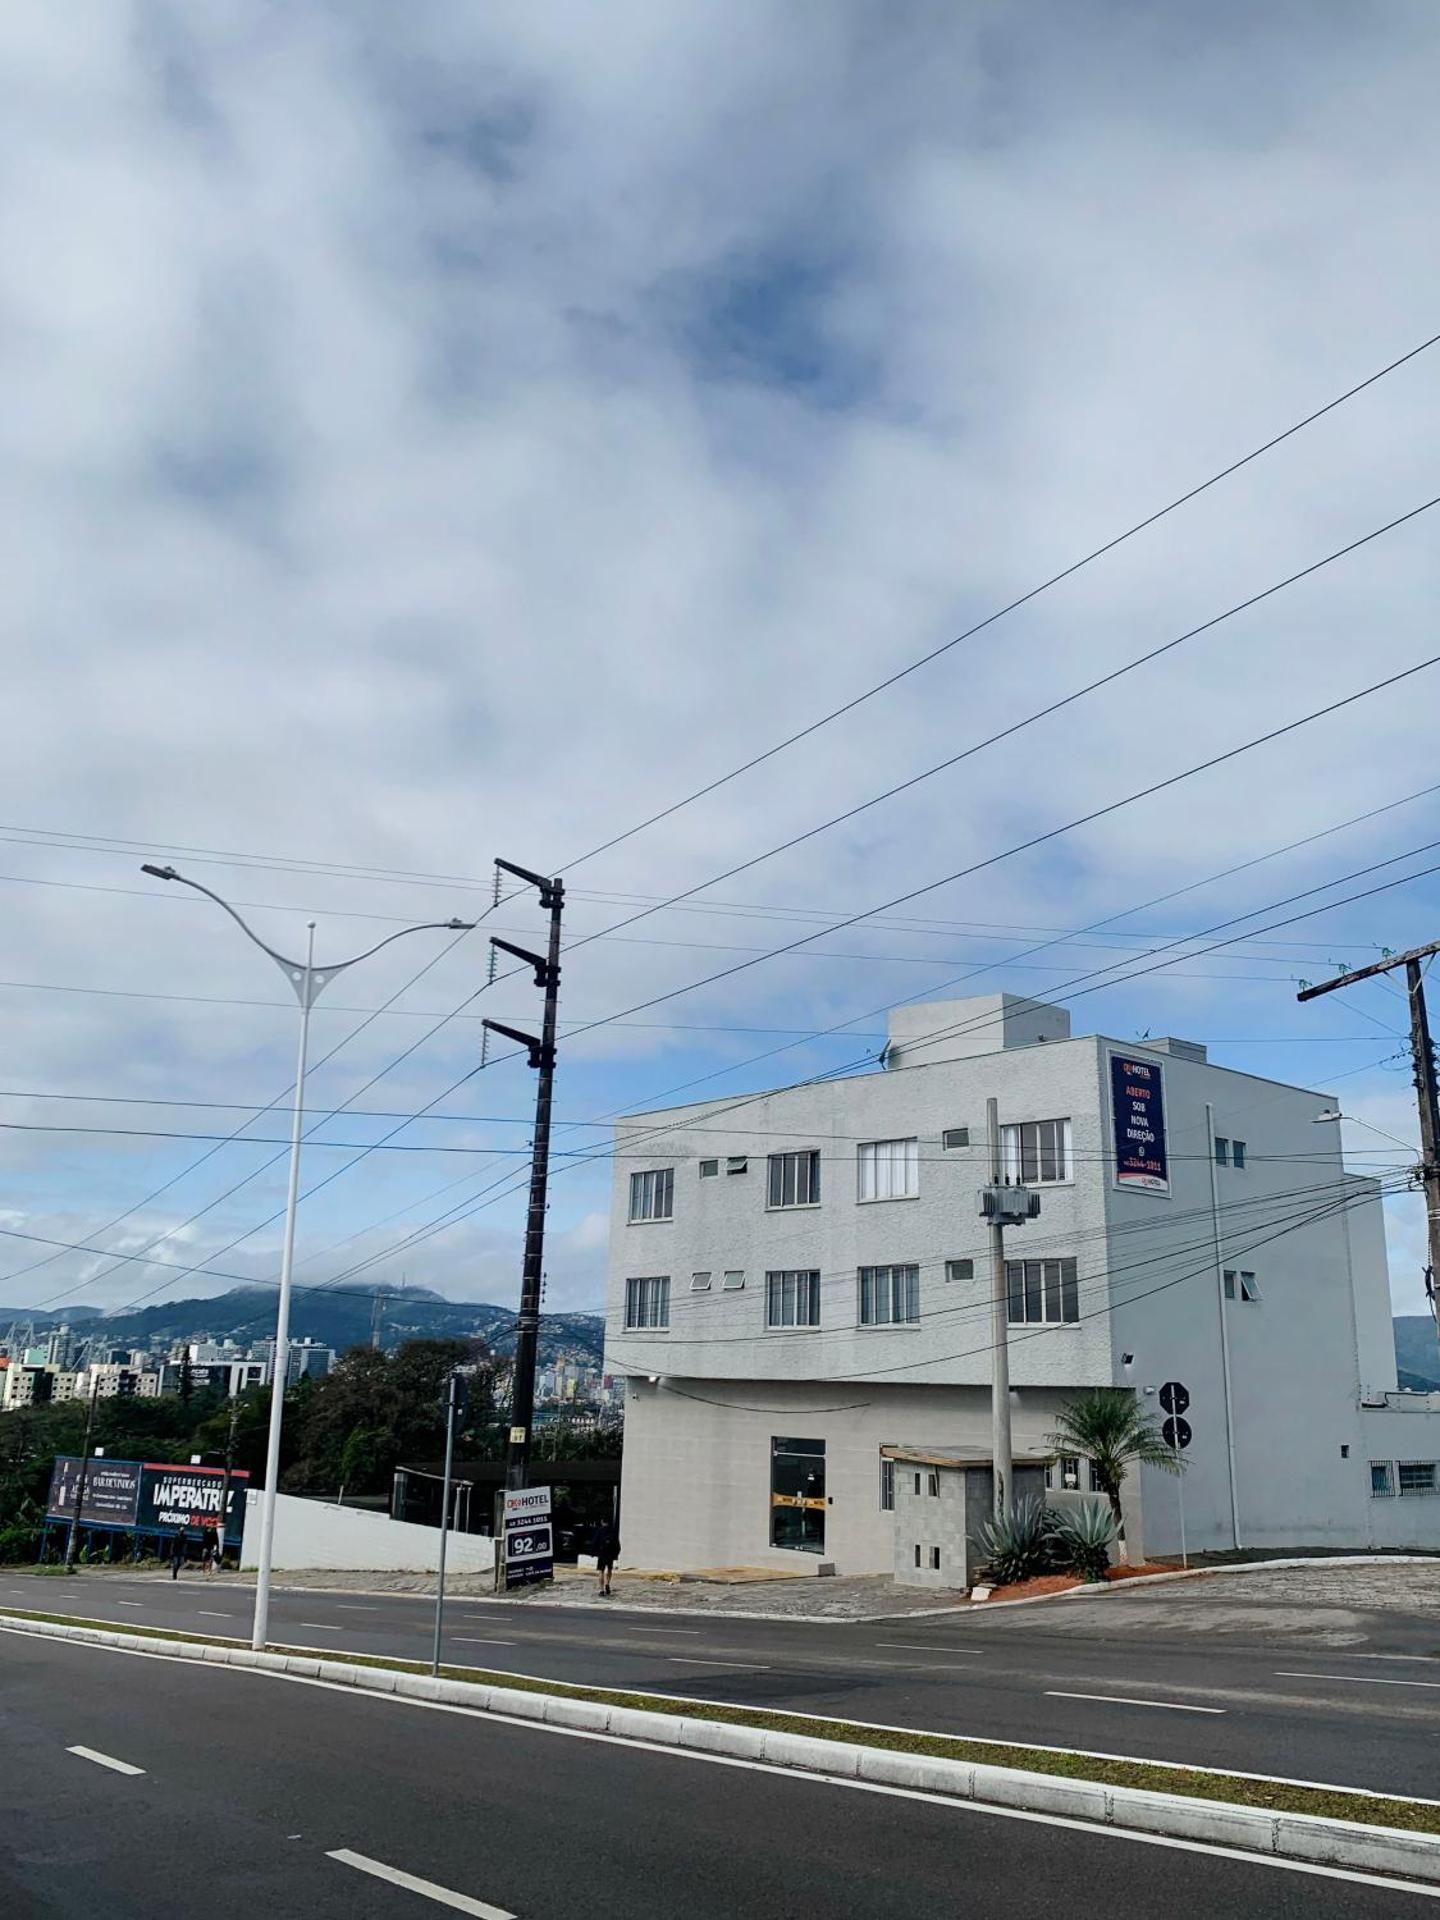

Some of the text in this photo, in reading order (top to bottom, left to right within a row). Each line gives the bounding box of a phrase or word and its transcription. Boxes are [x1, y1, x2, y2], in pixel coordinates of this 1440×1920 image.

[1125, 1085, 1150, 1099] ABERTO
[1132, 1101, 1146, 1112] SOB
[1131, 1115, 1149, 1127] NOVA
[1127, 1128, 1155, 1143] DIREÇÃO
[522, 1495, 549, 1506] HOTEL
[158, 1509, 190, 1525] PRÓXIMO
[514, 1537, 533, 1554] 92
